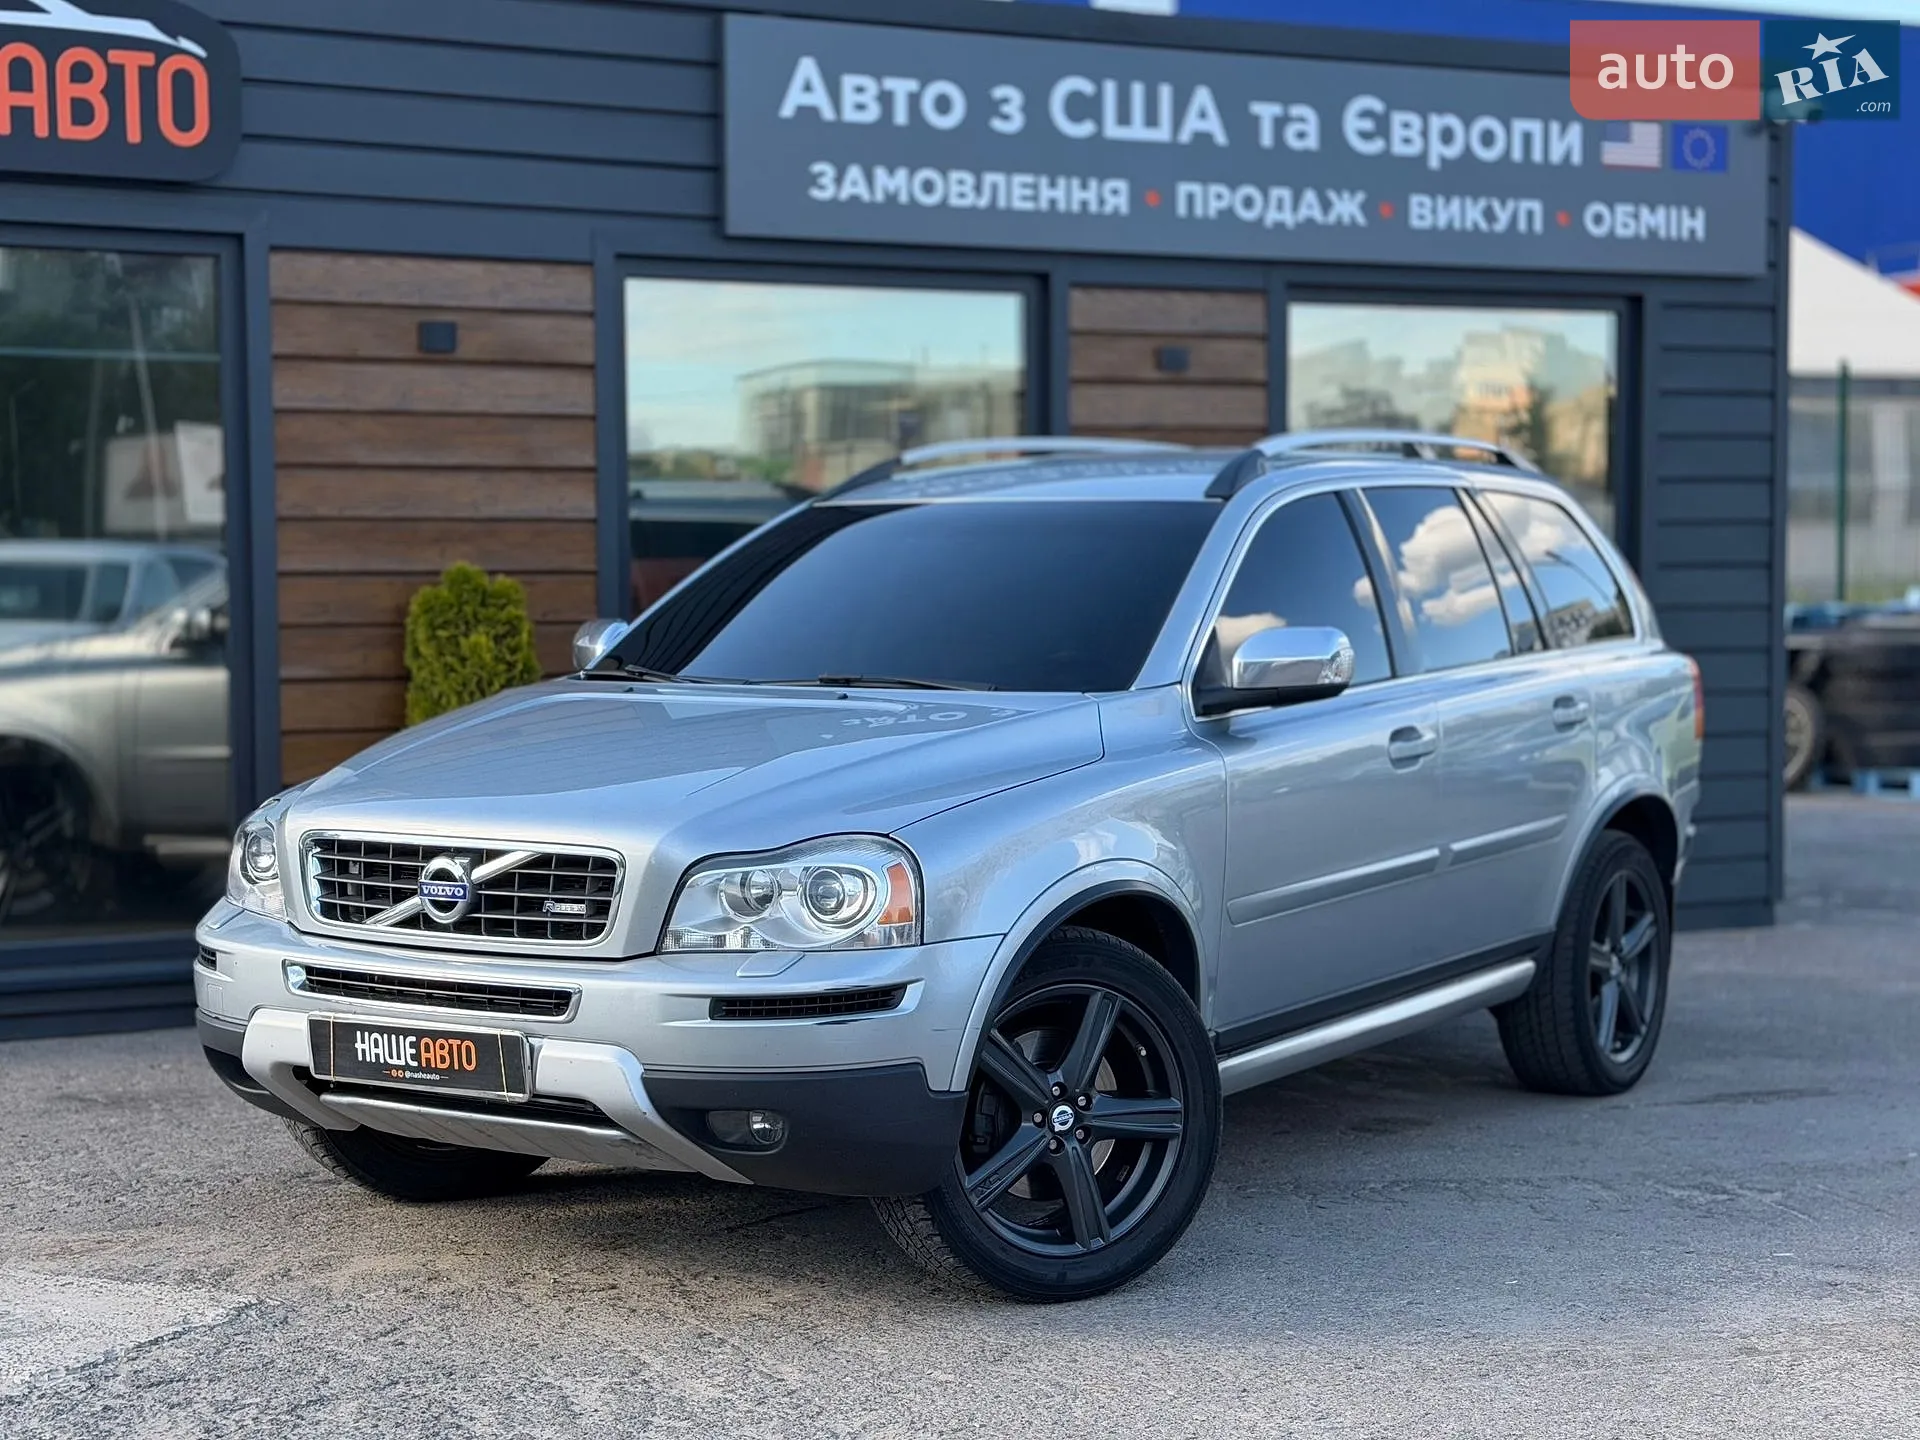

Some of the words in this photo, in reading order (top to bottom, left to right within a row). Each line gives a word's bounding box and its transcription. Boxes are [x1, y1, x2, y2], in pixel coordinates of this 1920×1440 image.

[0, 42, 210, 148] АВТО
[778, 56, 967, 130] Авто
[1048, 75, 1229, 146] США
[1249, 101, 1319, 151] та
[1342, 95, 1584, 170] Європи
[808, 161, 1129, 215] ЗАМОВЛЕННЯ
[1176, 181, 1366, 228] ПРОДАЖ
[1409, 194, 1543, 234] ВИКУП
[1583, 201, 1706, 241] ОБМІН
[421, 885, 464, 897] VOLVO
[354, 1030, 418, 1067] НАШЕ
[420, 1037, 476, 1071] АВТО
